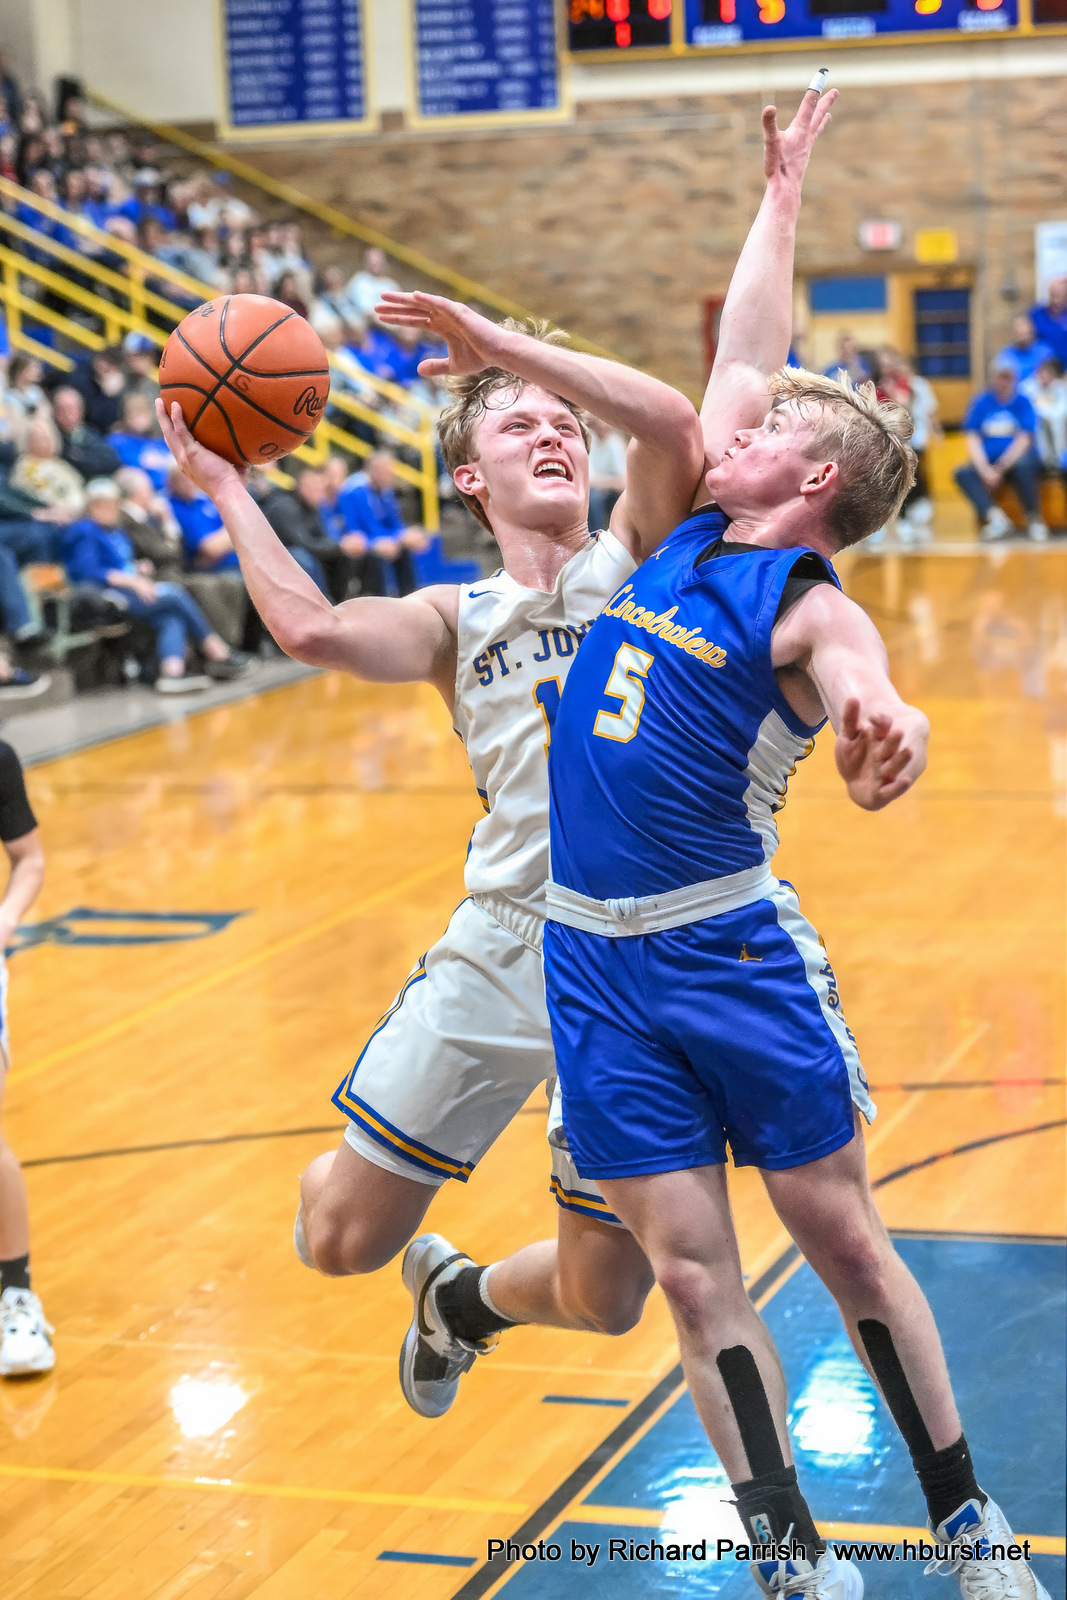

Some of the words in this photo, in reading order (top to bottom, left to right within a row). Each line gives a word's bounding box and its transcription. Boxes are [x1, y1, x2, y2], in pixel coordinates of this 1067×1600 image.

[472, 640, 523, 687] ST.
[532, 618, 600, 663] JOH
[602, 583, 727, 669] Lincolnview
[593, 641, 655, 744] 5
